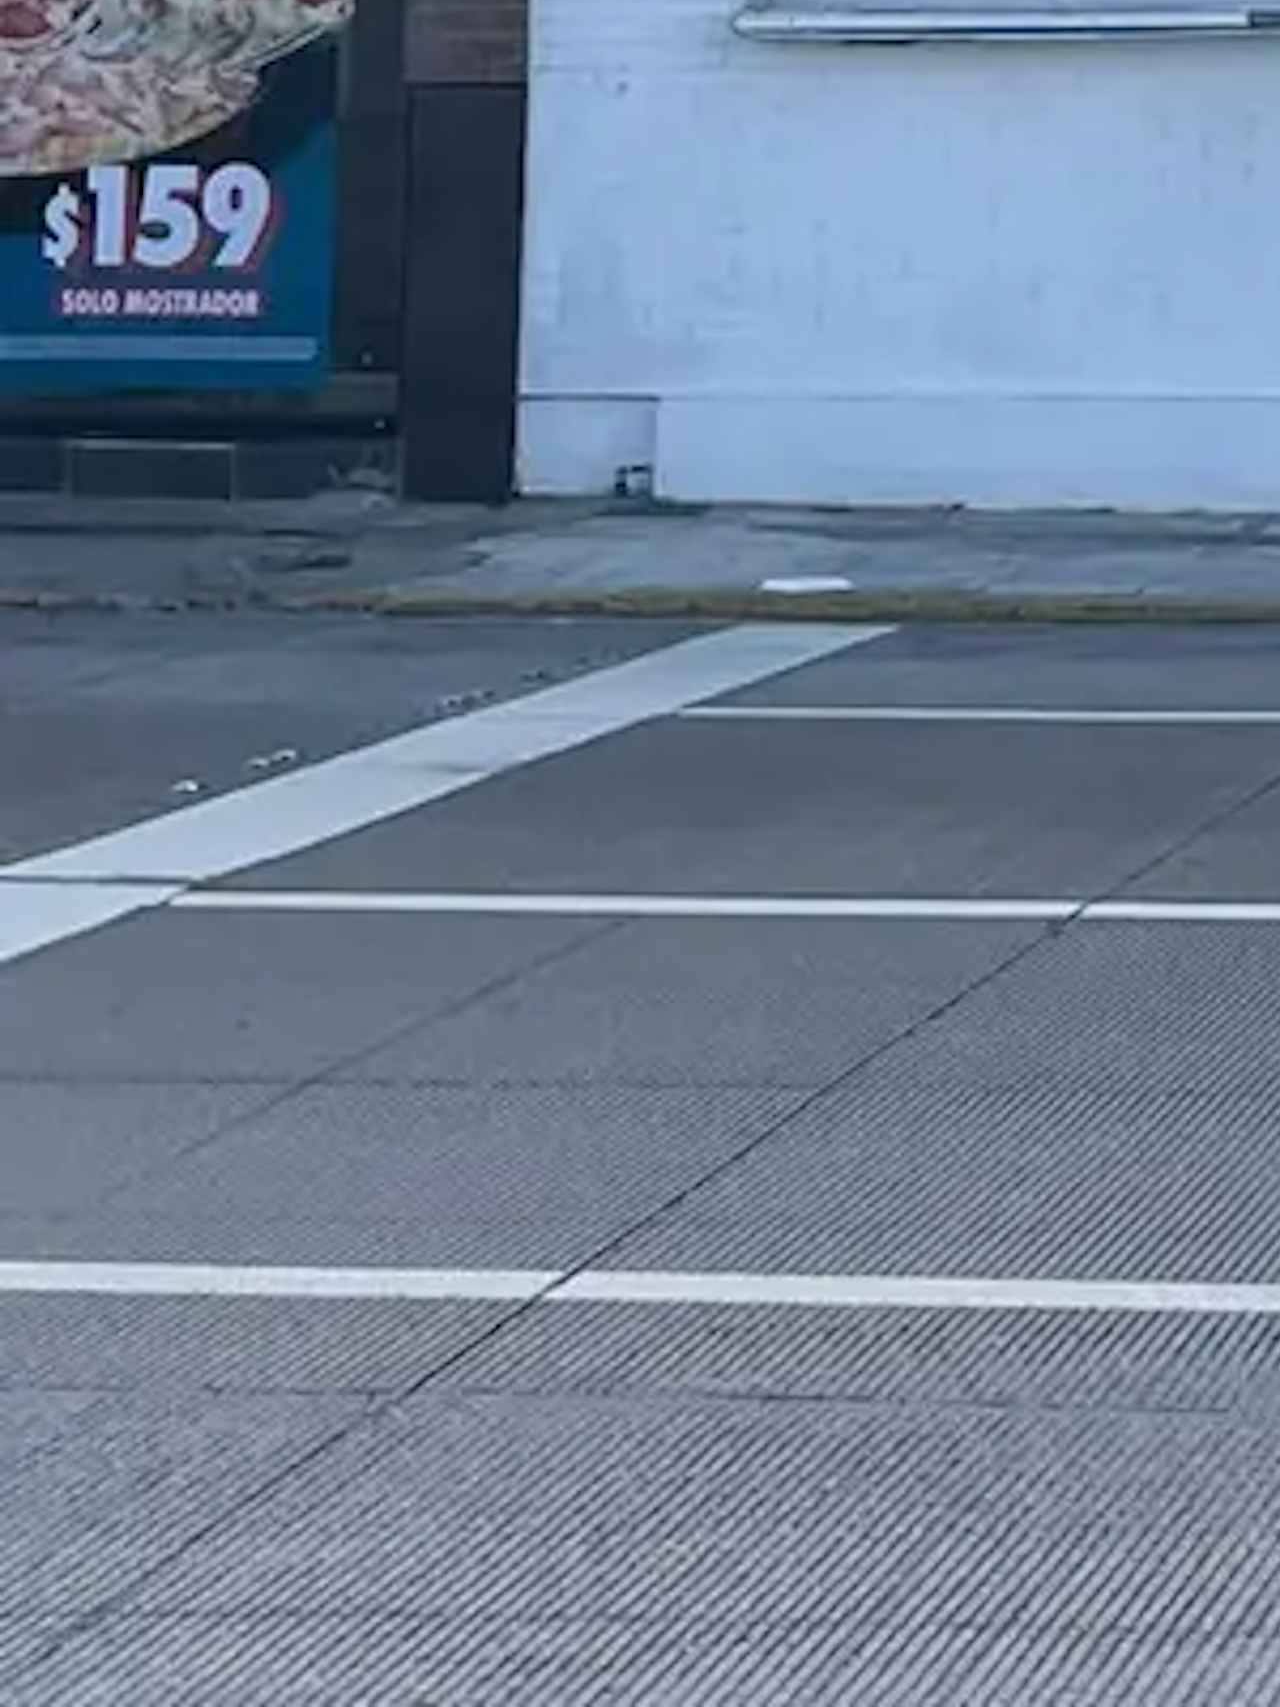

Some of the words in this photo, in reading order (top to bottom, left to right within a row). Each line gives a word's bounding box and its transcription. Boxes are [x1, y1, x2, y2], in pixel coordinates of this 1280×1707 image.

[41, 162, 273, 268] $159
[61, 289, 120, 316] SOLO
[123, 289, 260, 317] MOSTRADOR
